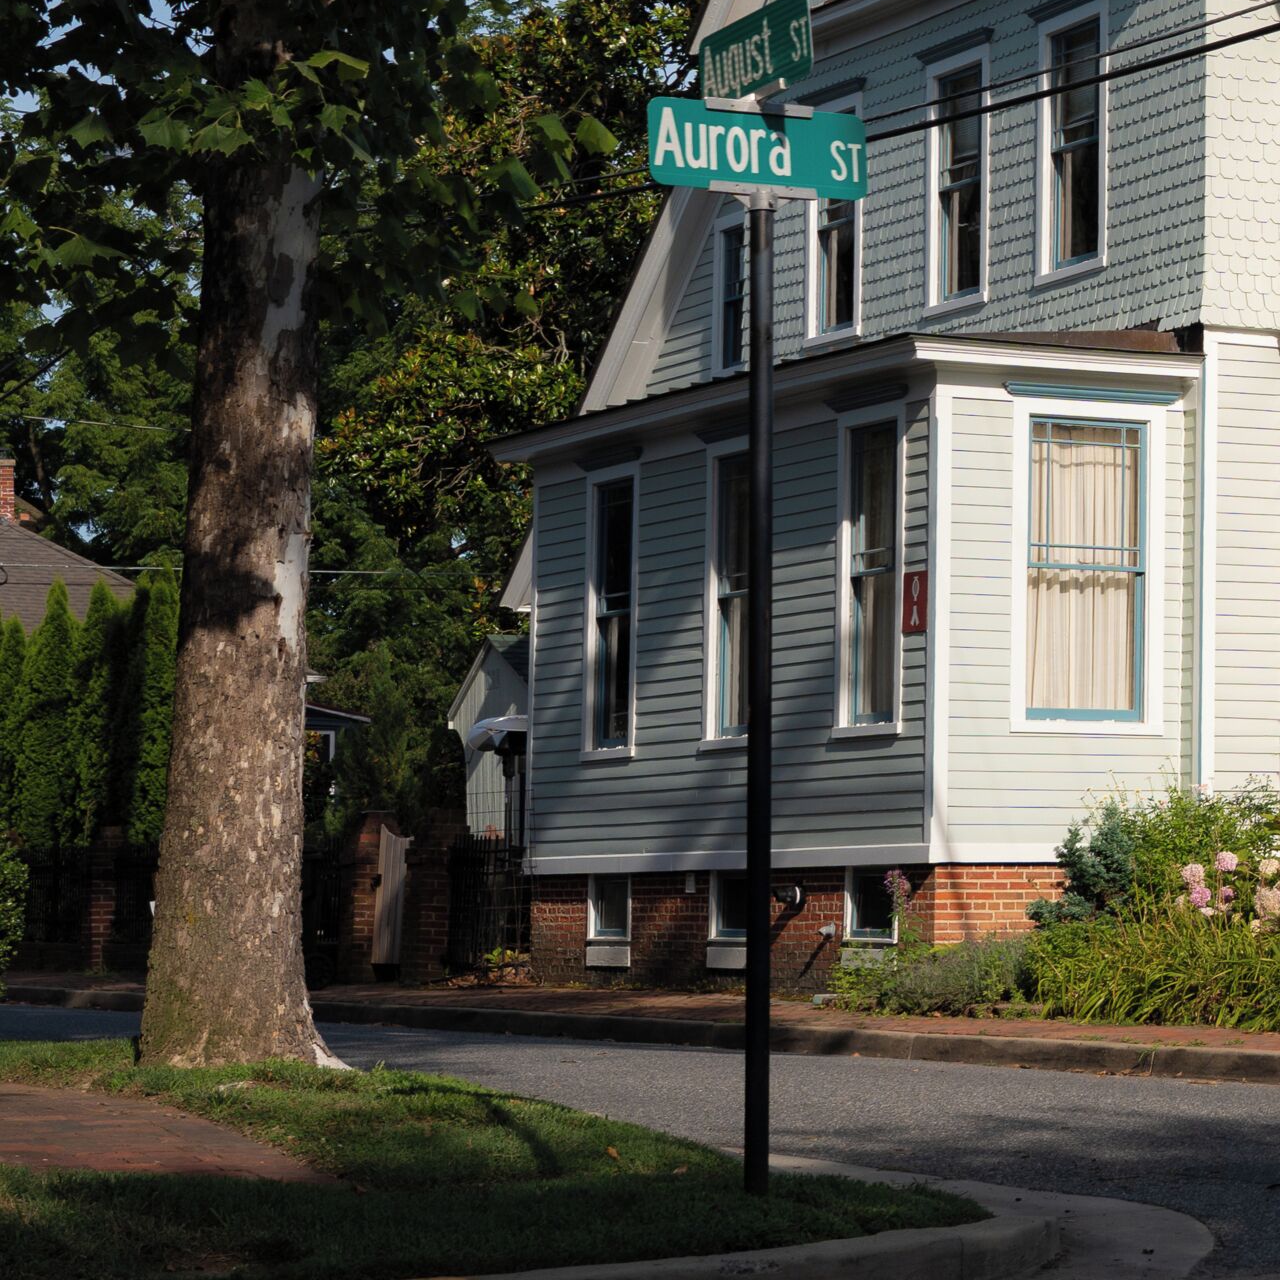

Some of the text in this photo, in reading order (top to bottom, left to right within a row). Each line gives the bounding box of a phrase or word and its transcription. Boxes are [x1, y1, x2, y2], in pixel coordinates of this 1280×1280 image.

[703, 16, 808, 99] August ST
[654, 107, 862, 183] Aurora ST
